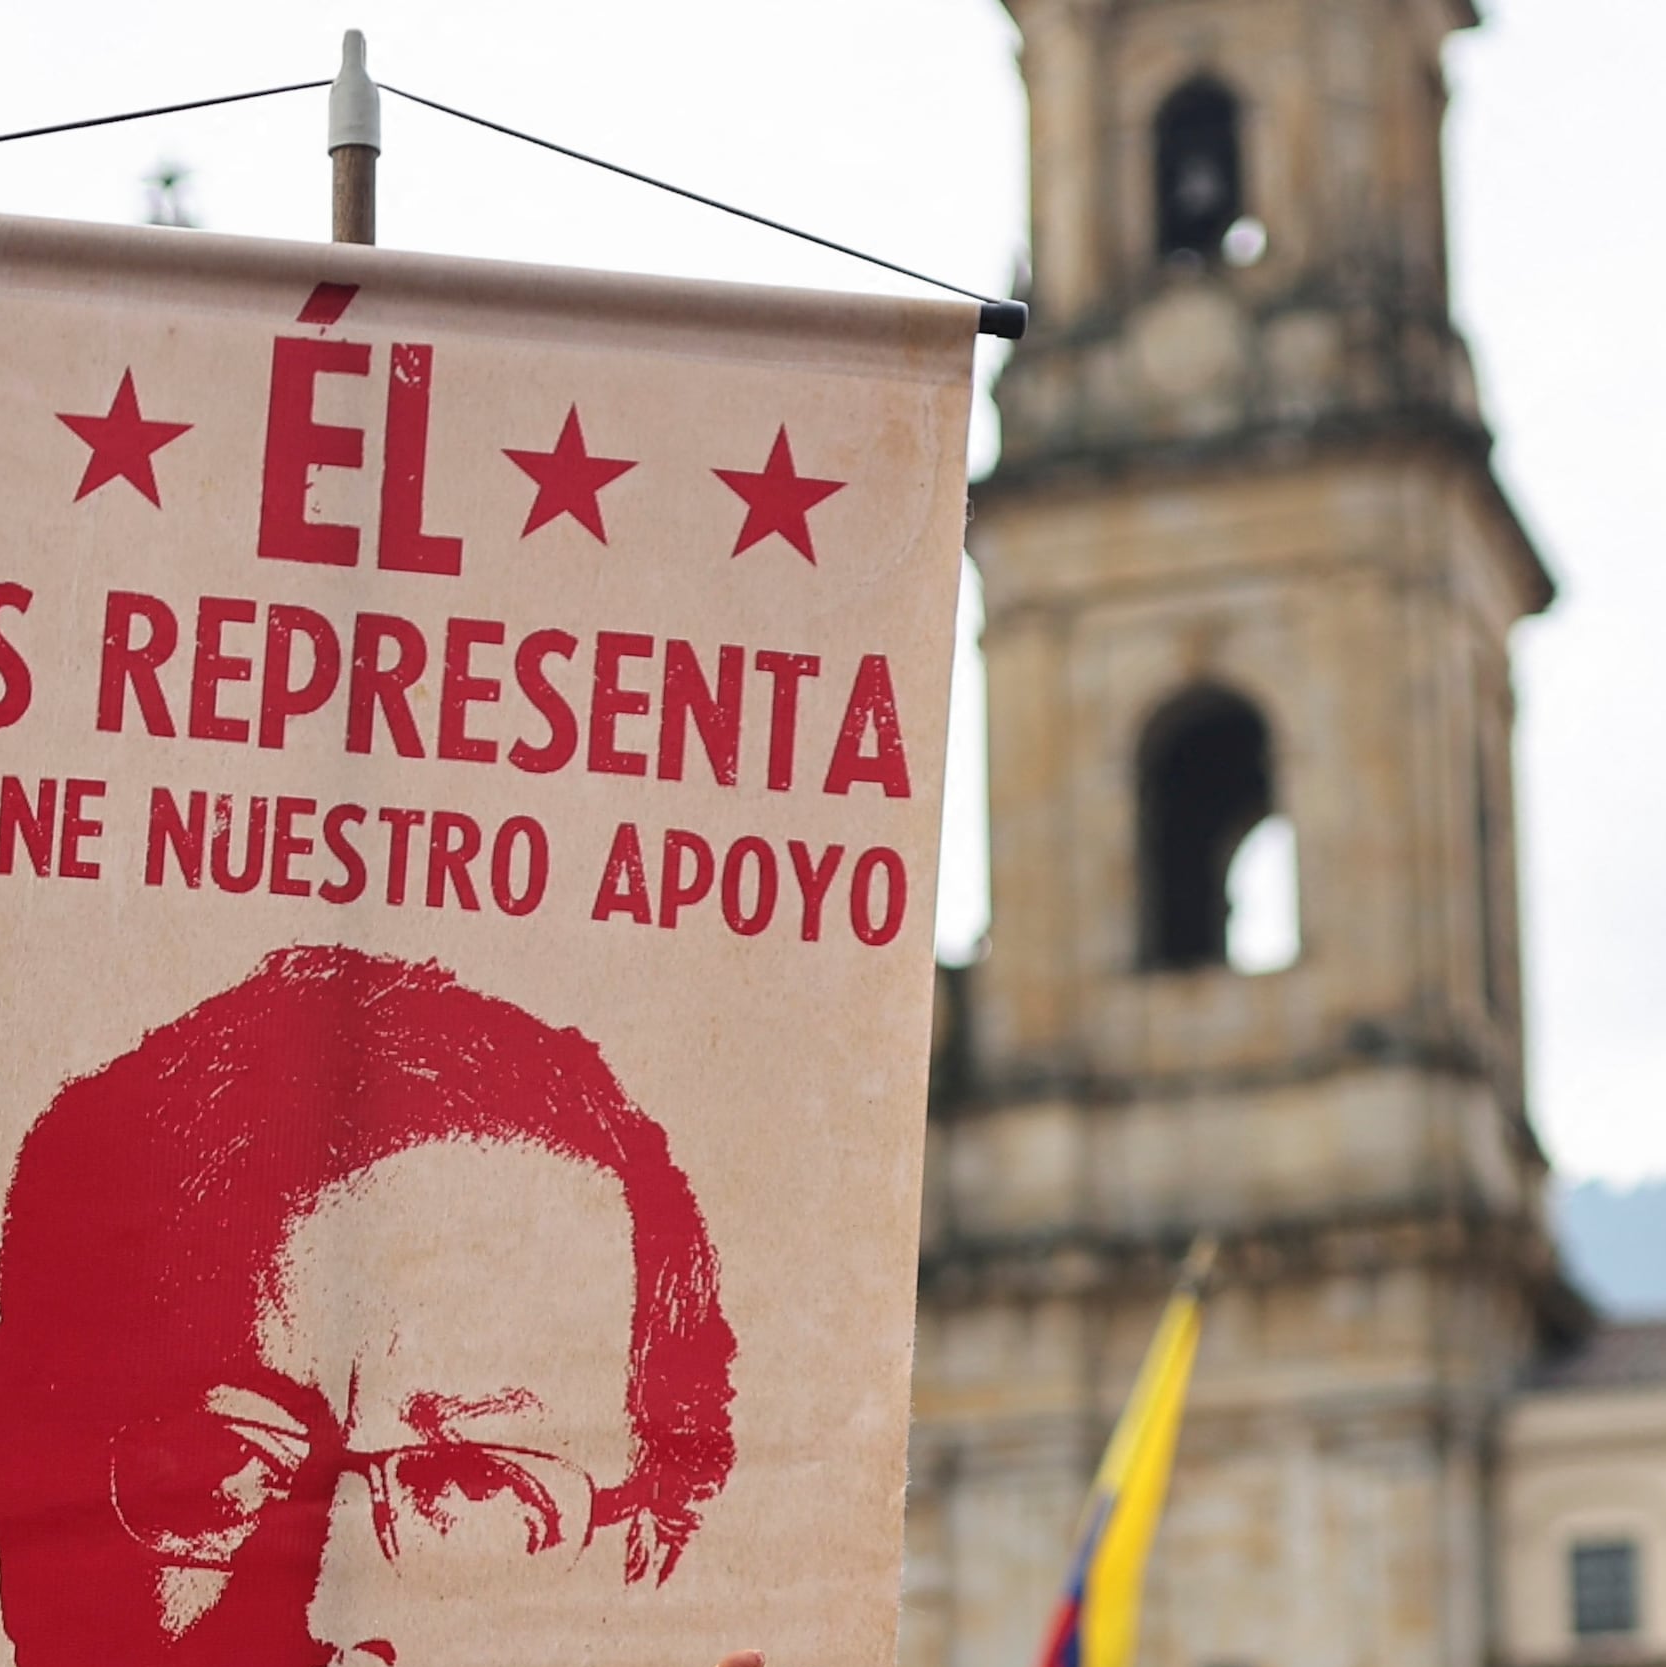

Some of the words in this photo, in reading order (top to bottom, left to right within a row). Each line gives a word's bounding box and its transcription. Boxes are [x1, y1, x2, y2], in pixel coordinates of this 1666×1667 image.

[257, 282, 463, 577] ÉL
[96, 590, 913, 800] REPRESENTA
[144, 786, 550, 918] NUESTRO
[591, 822, 909, 948] APOYO
